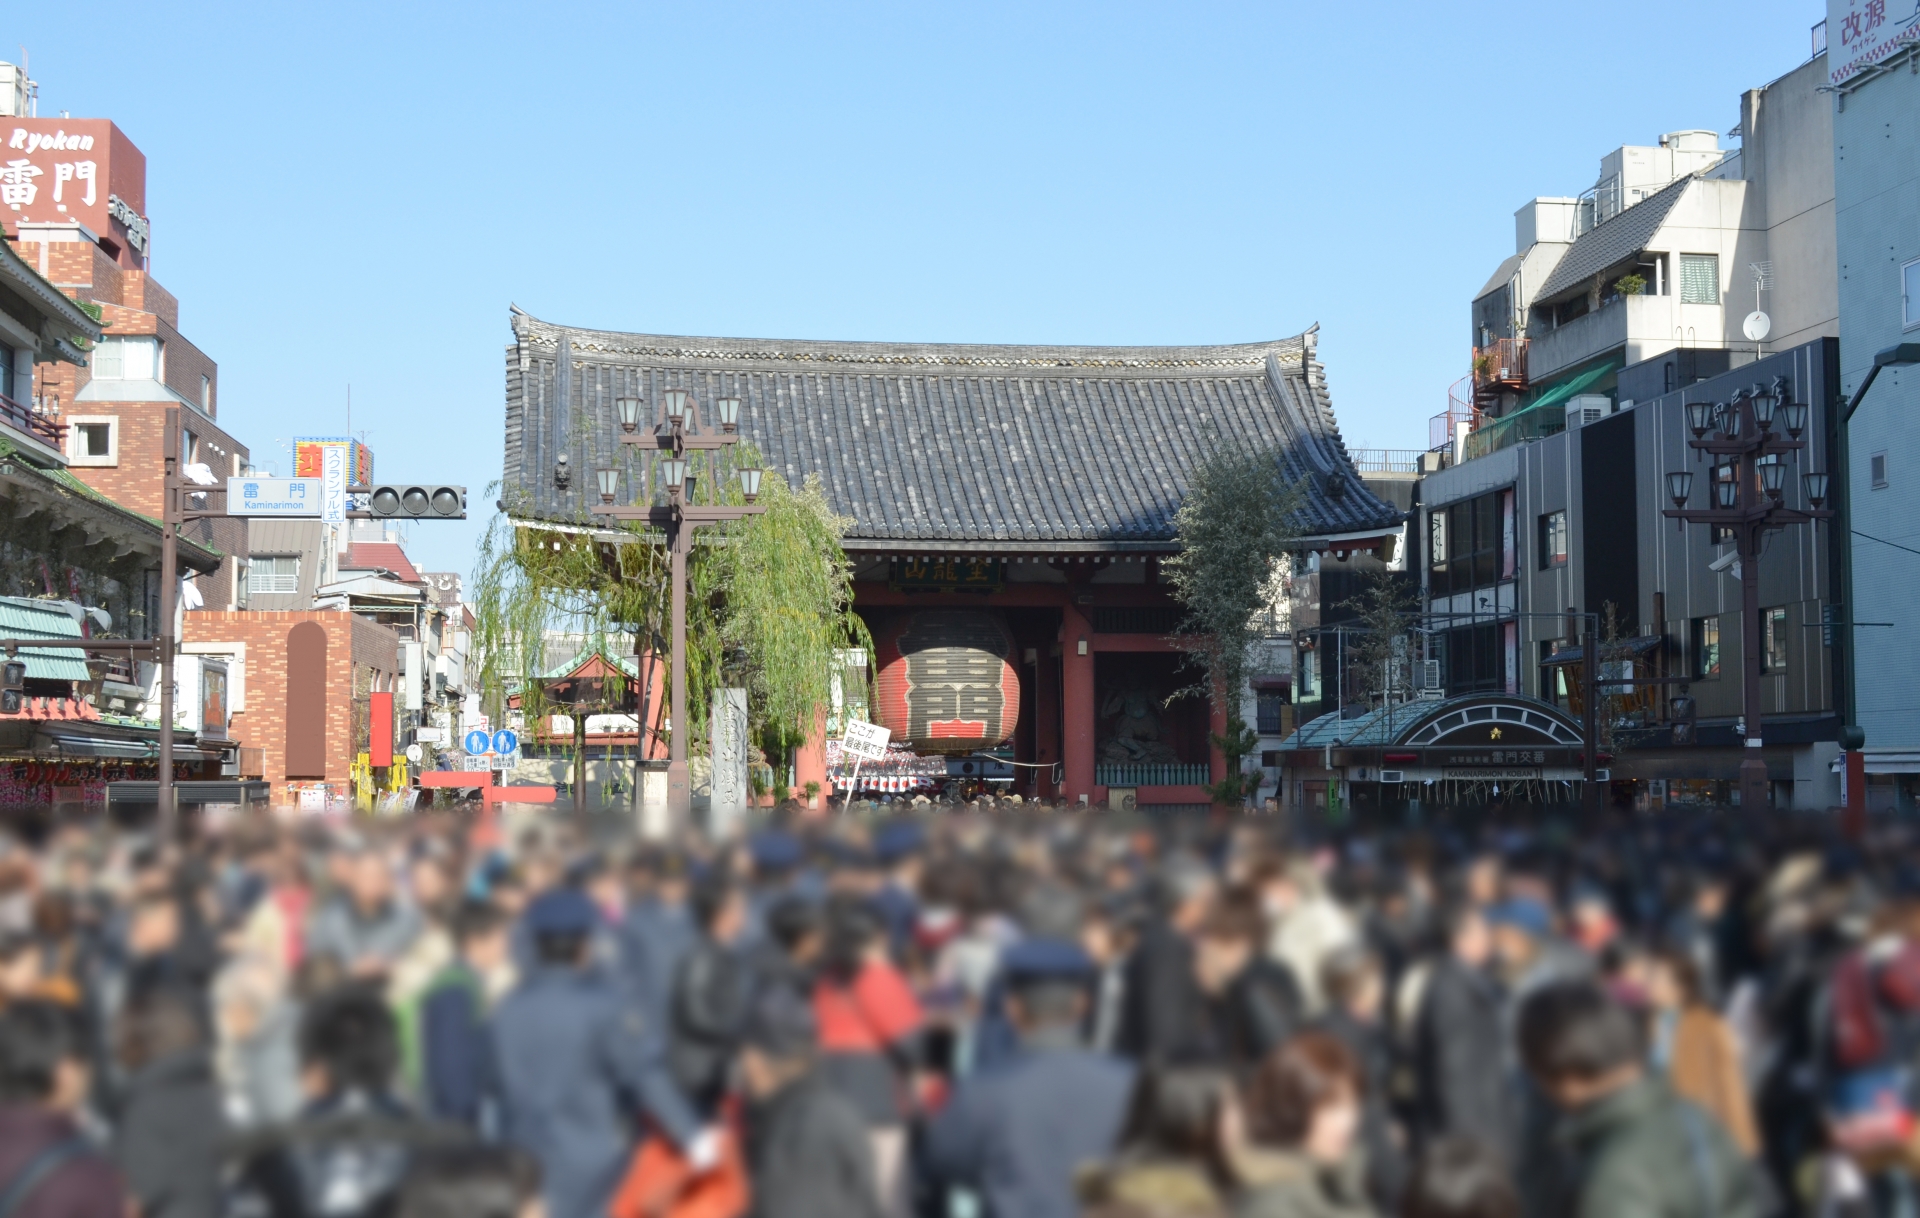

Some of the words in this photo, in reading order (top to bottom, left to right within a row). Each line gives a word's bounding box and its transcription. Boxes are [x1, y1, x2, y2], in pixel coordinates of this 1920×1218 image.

[1841, 0, 1886, 46] 改源
[1851, 33, 1877, 54] カイゲン
[9, 128, 94, 154] Ryokan
[0, 159, 97, 207] 雷門
[243, 482, 306, 499] 雷門
[328, 449, 341, 520] スクランブル式
[244, 500, 304, 510] Kaminarimon
[897, 610, 1009, 739] 雷門
[849, 723, 876, 739] ここが
[845, 736, 885, 757] 最後尾です
[1492, 751, 1546, 764] 雷門交番
[1448, 770, 1503, 778] KAMINARIMON
[1506, 770, 1533, 778] KOBAN
